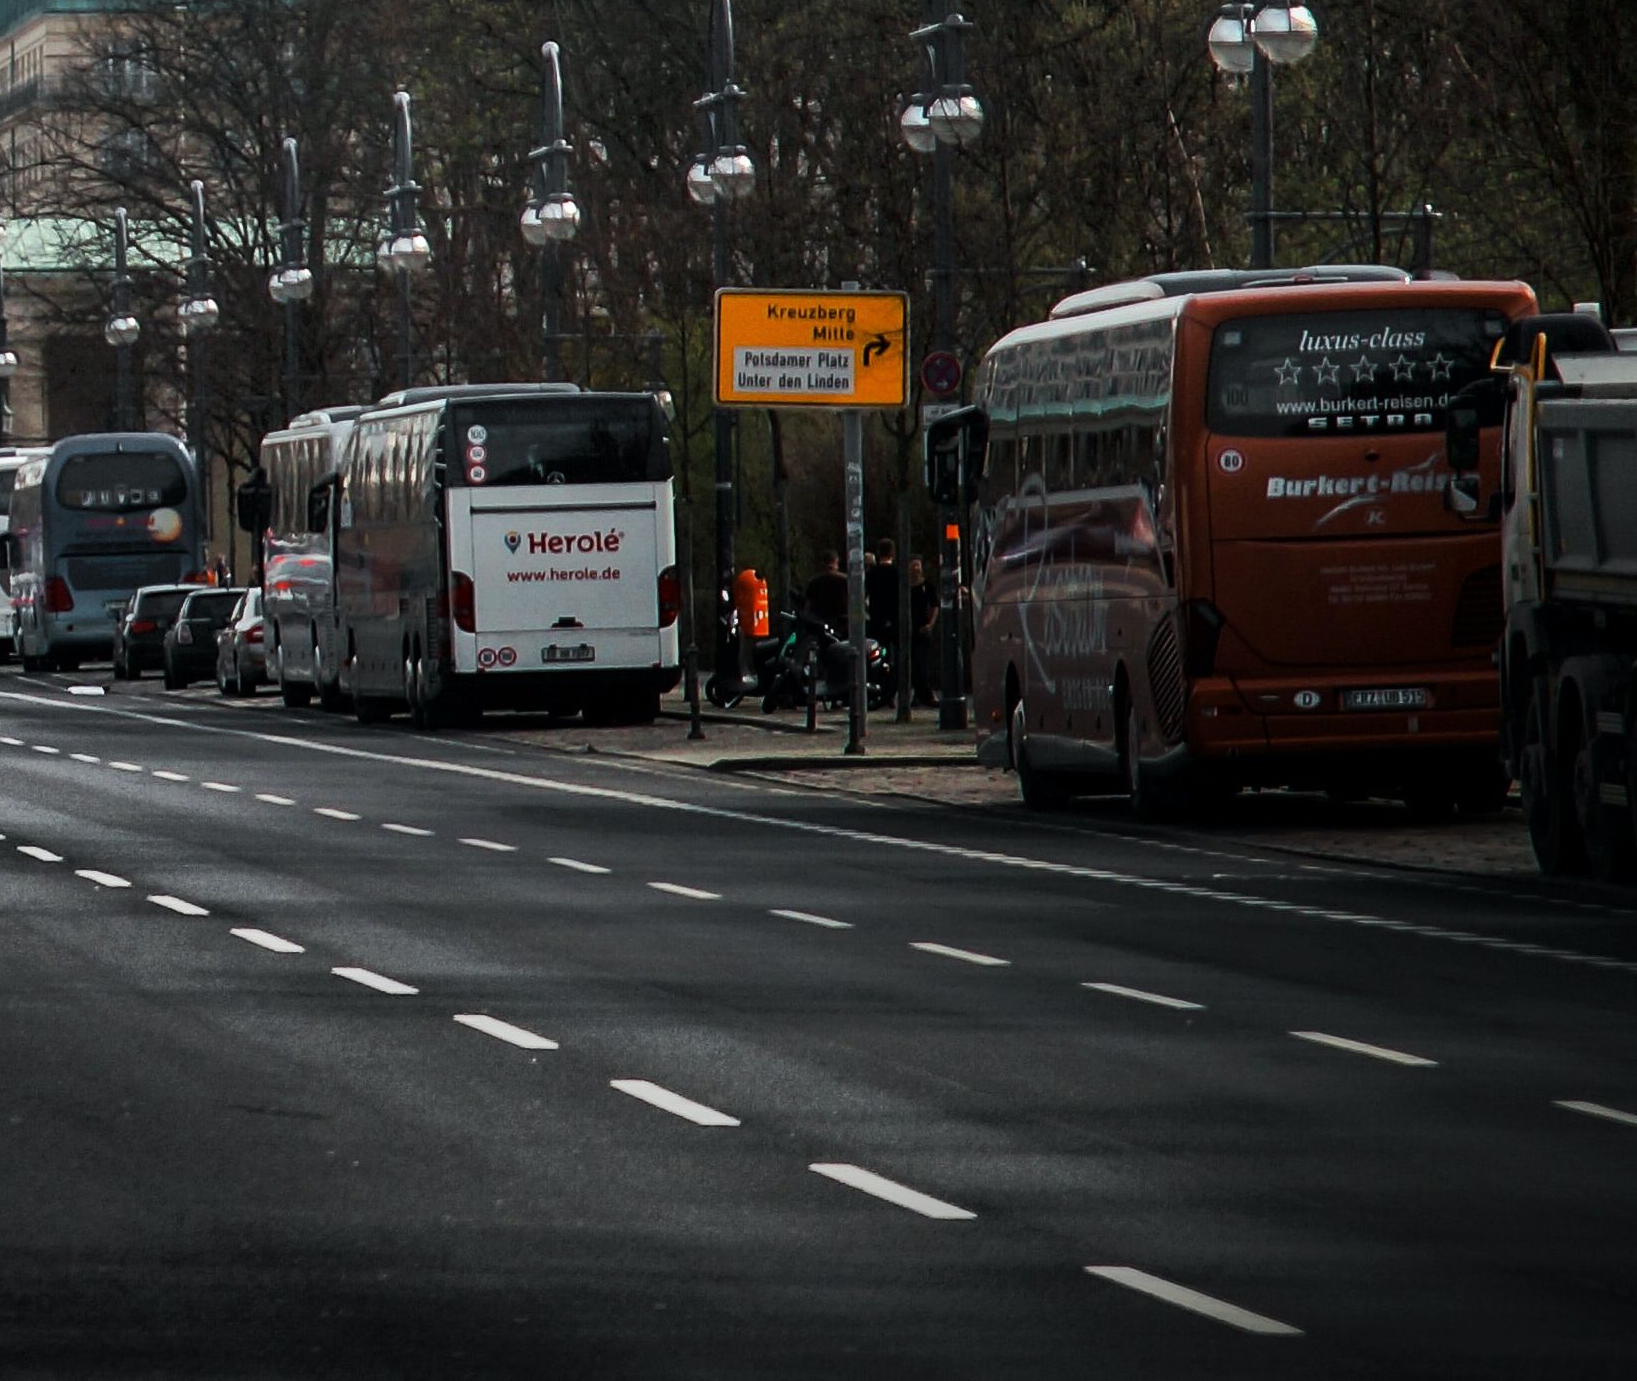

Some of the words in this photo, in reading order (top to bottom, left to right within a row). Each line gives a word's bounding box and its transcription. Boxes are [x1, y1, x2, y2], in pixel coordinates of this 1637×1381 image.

[767, 304, 856, 323] Kreuzberg
[813, 326, 854, 341] Mitte
[1298, 326, 1426, 352] luxus-class
[744, 351, 811, 368] Potsdamer
[818, 352, 849, 368] Platz
[738, 372, 772, 389] Unter
[778, 372, 801, 389] den
[807, 373, 849, 389] Linden
[1308, 413, 1433, 429] SETRA
[1266, 472, 1480, 498] Burkert-Reis
[527, 528, 620, 554] Herolé
[507, 566, 621, 582] www.herole.de
